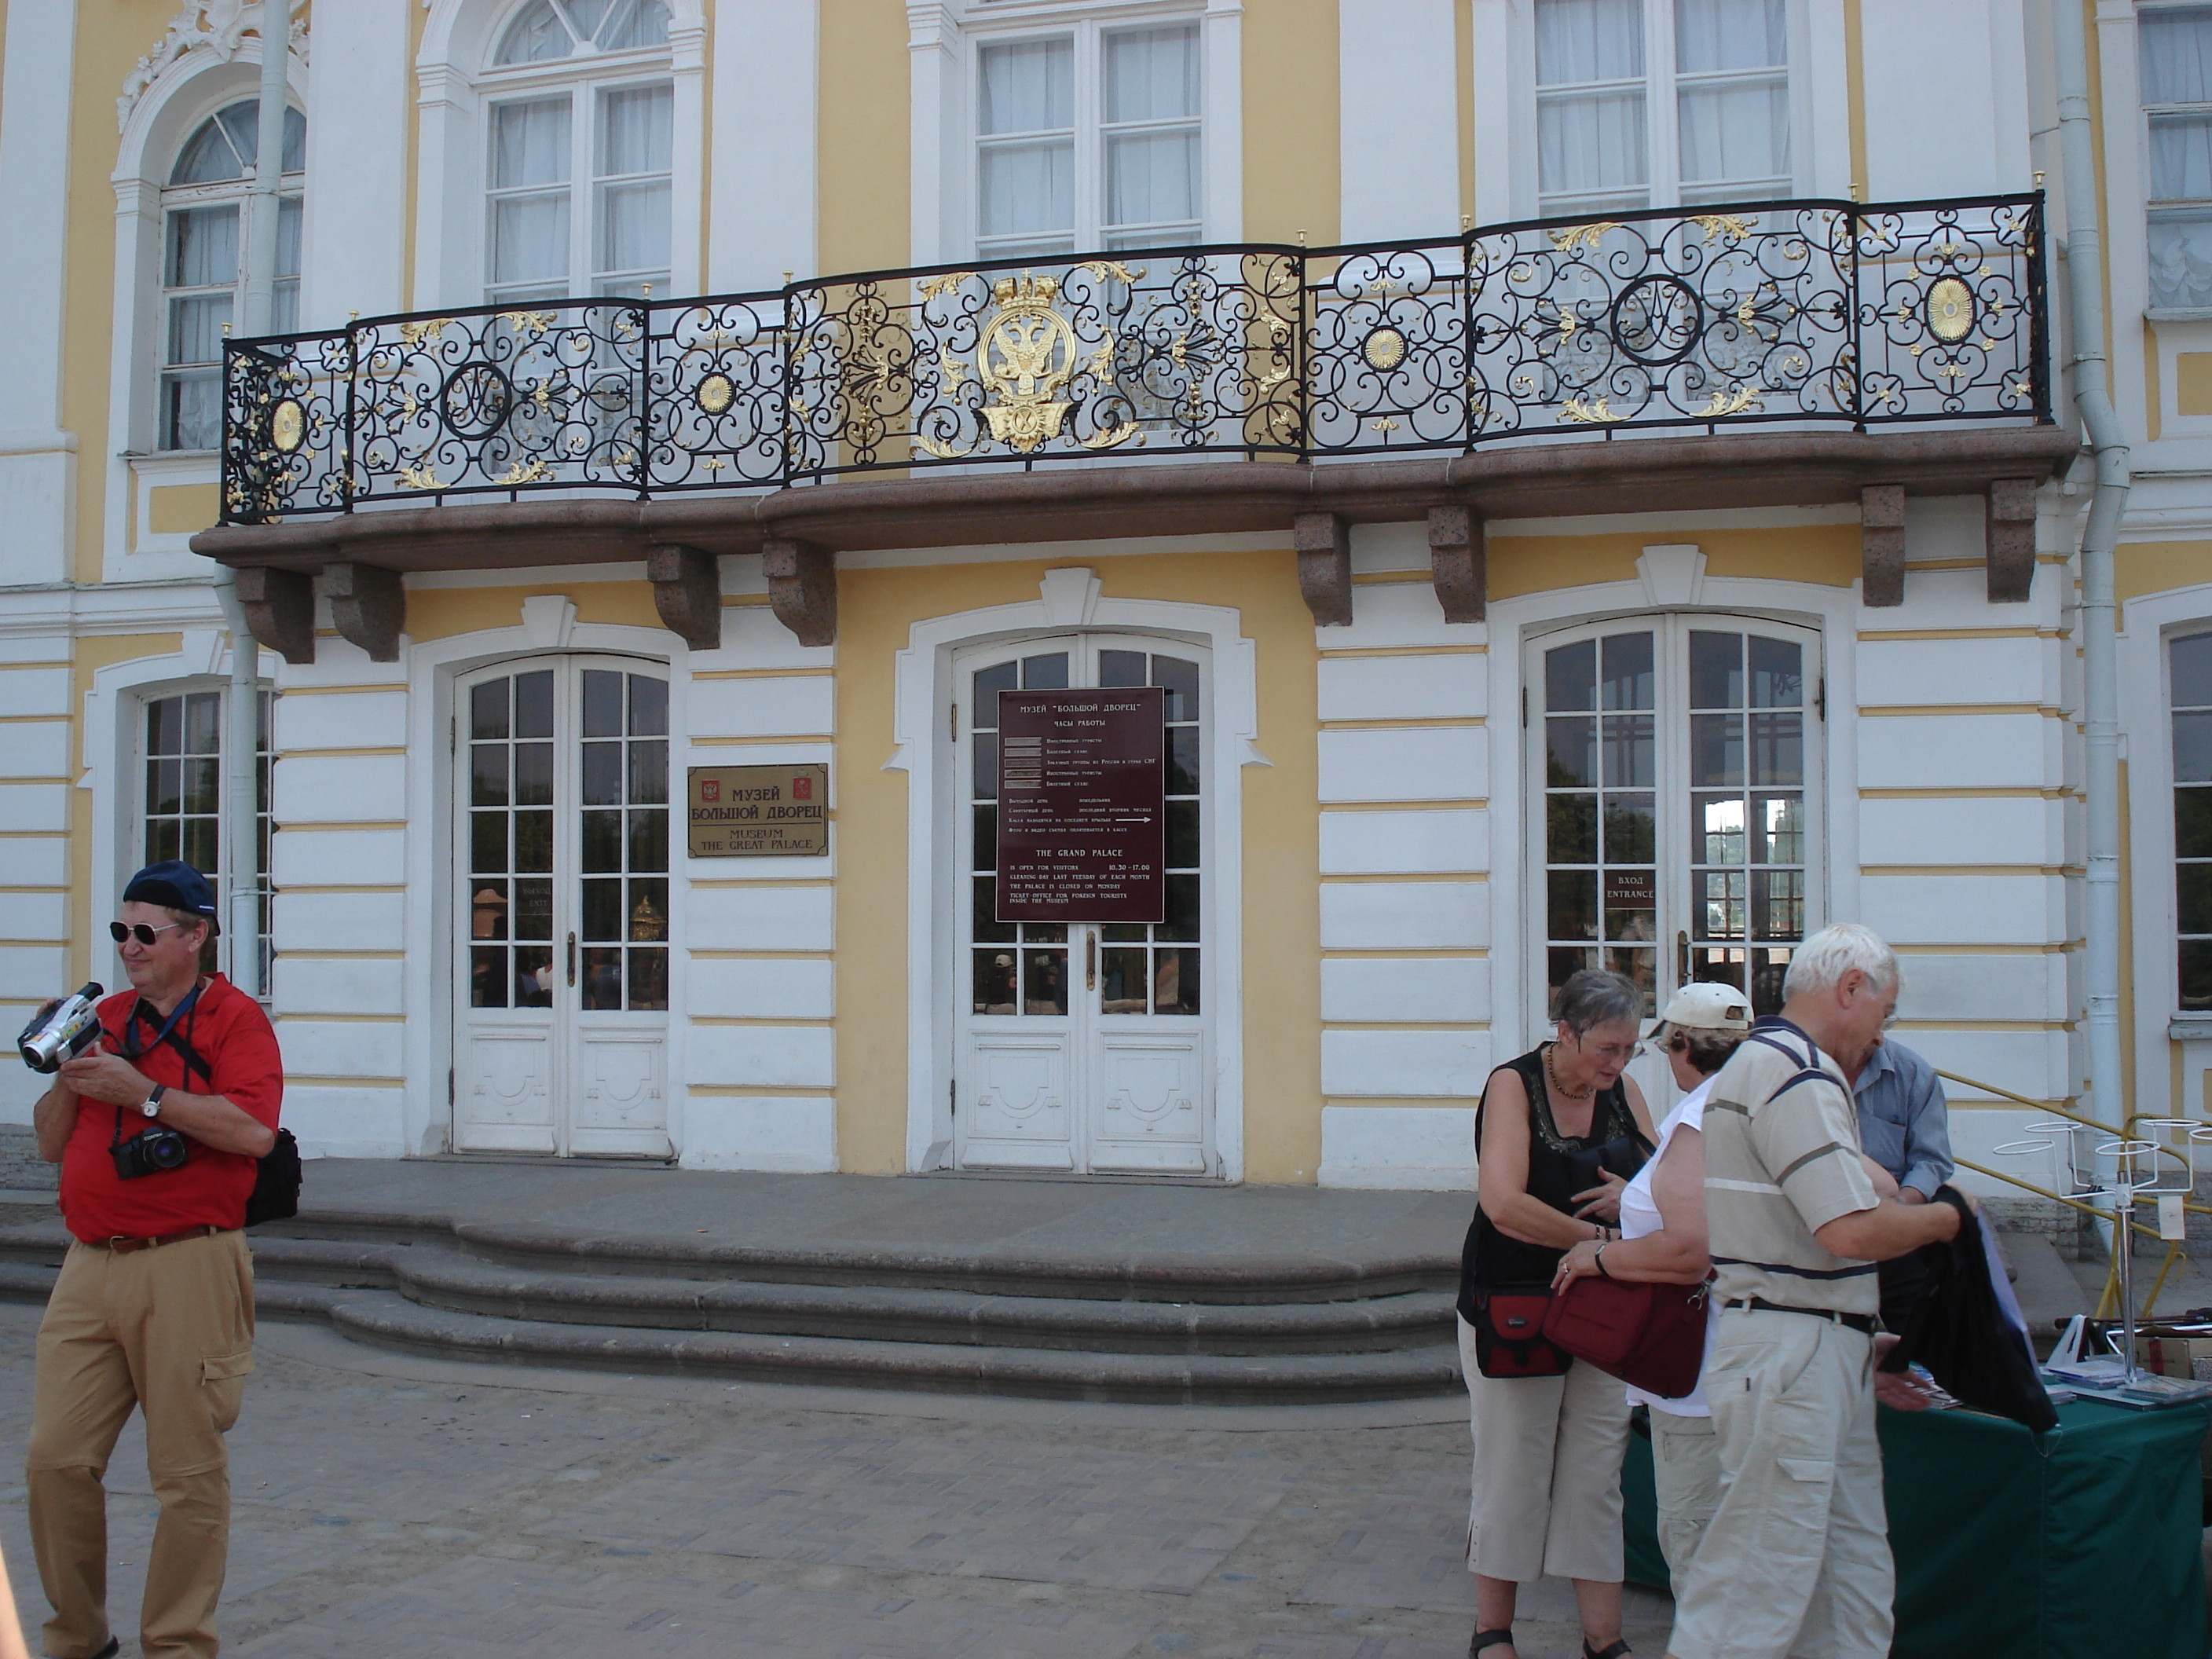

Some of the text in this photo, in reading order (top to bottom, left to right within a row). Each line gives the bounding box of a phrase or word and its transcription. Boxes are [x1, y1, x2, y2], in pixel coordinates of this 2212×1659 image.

[1020, 705, 1047, 713] МУЗЕЙ
[733, 786, 780, 802] МУЗЕЙ
[691, 804, 822, 821] БОЛЬШОЙ ДВОРЕЦ
[730, 829, 783, 840] MUSEUM
[701, 840, 813, 851] THE GREAT PALACE
